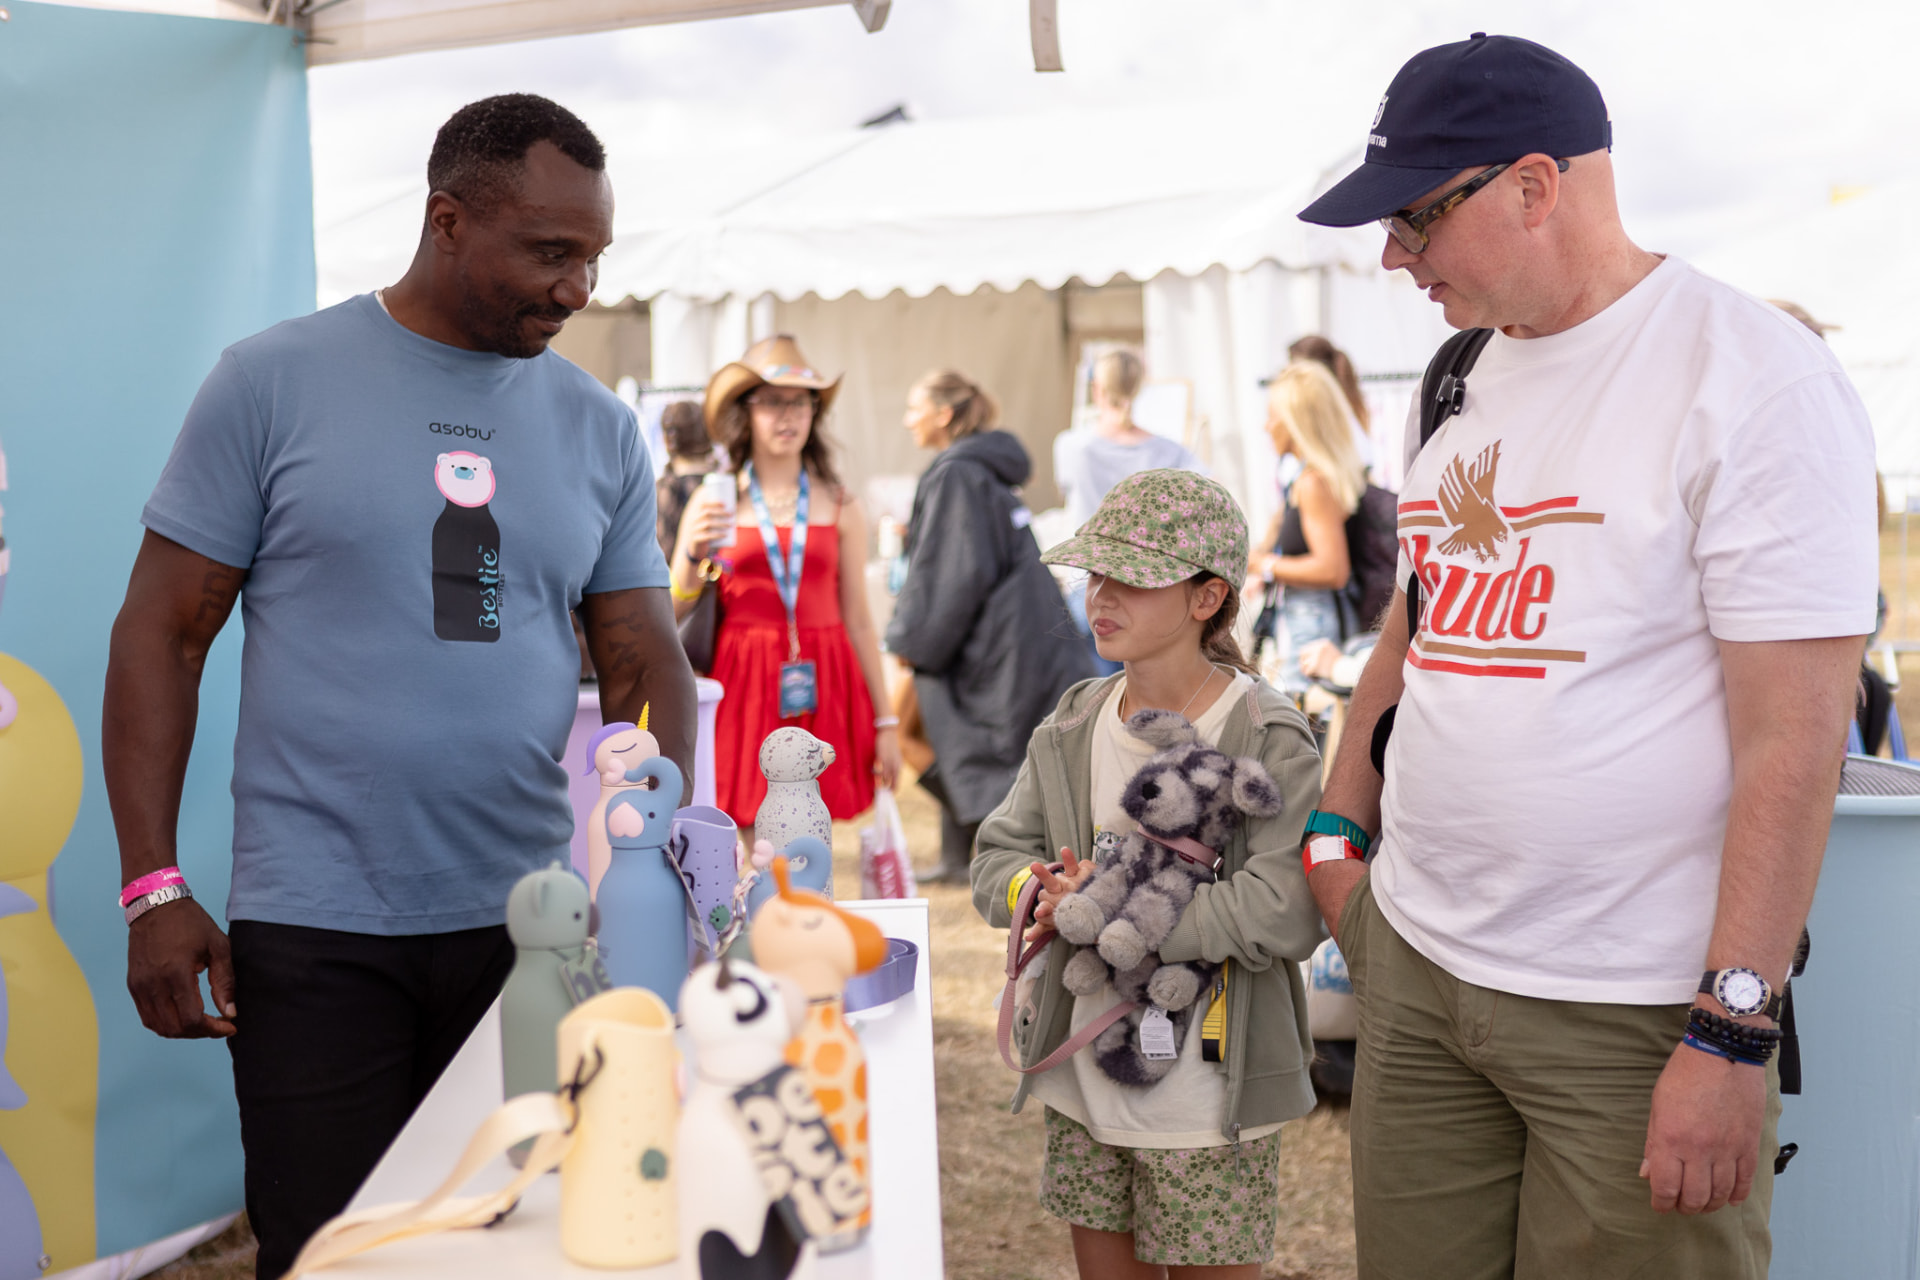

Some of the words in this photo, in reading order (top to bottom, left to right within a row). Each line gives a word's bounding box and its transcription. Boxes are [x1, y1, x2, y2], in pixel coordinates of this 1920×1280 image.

[429, 422, 492, 441] asobu
[478, 548, 499, 629] Bestie
[1398, 533, 1555, 642] hude
